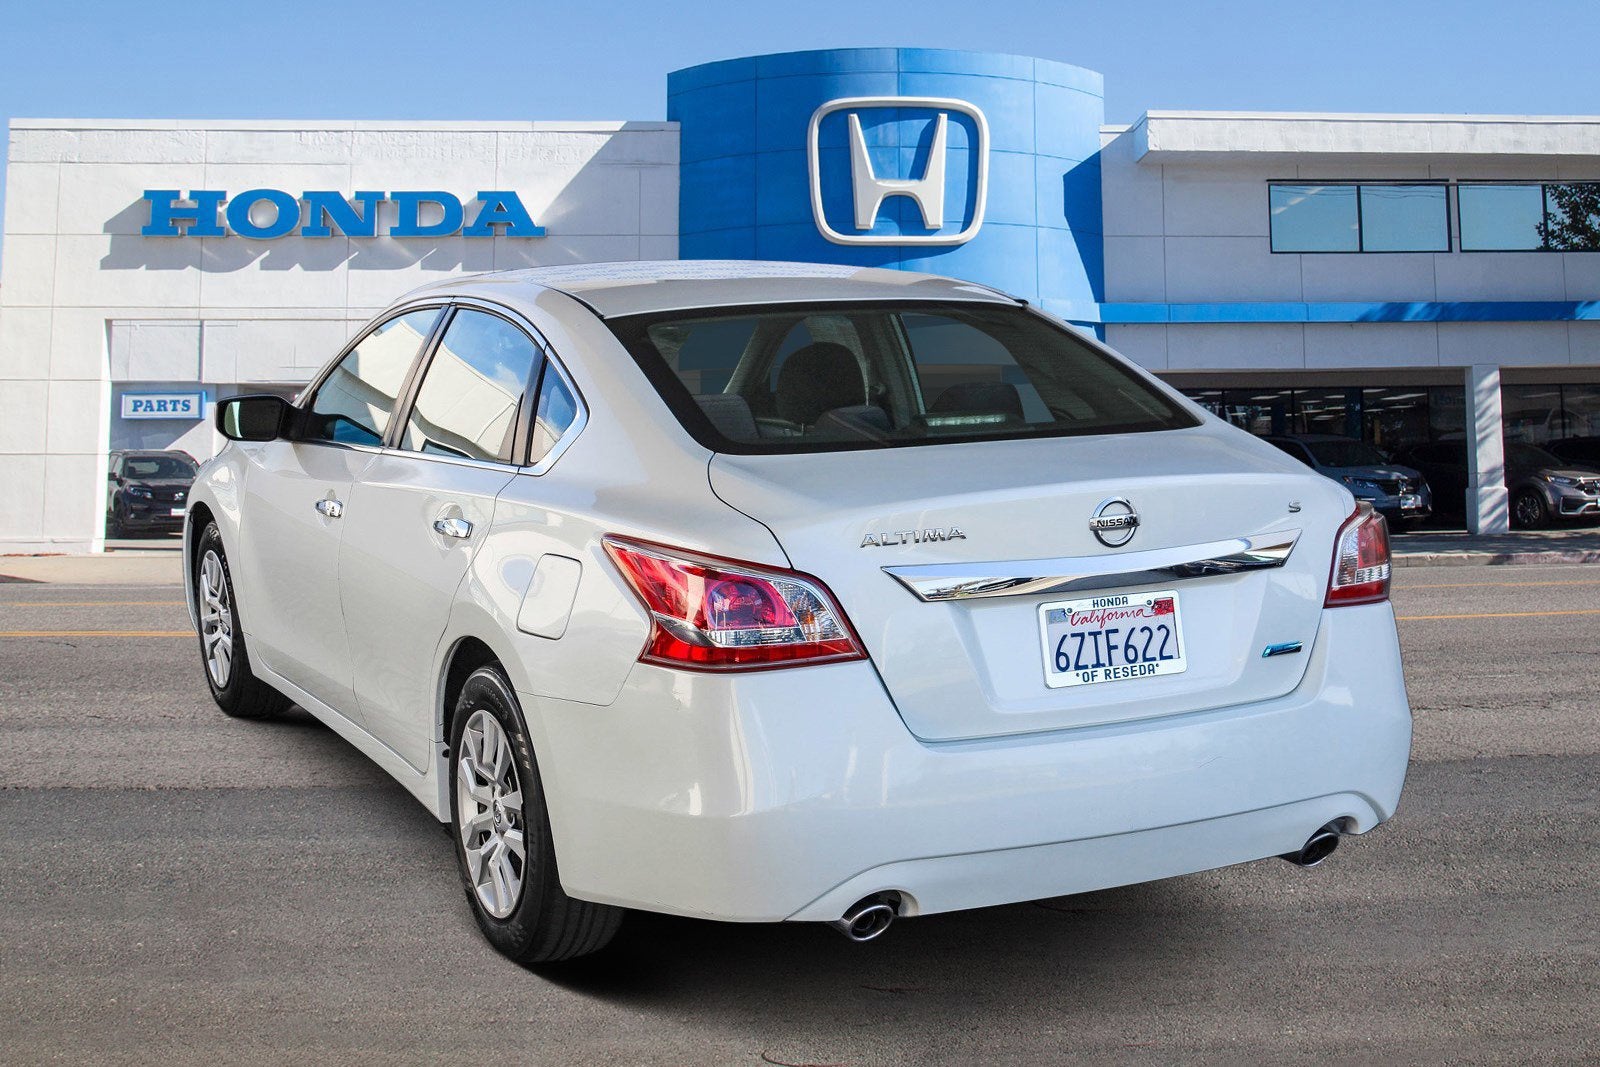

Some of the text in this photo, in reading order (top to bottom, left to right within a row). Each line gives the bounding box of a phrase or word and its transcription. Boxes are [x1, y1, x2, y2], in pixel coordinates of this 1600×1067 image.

[142, 188, 547, 239] HONDA
[131, 400, 191, 413] PARTS
[1288, 500, 1301, 513] S
[1096, 516, 1139, 528] NISSAN
[860, 526, 967, 548] ALTIMA
[1092, 596, 1129, 609] HONDA
[1070, 607, 1153, 629] California
[1055, 624, 1174, 672] 6ZIF622
[1082, 663, 1156, 683] OF RESEDA
